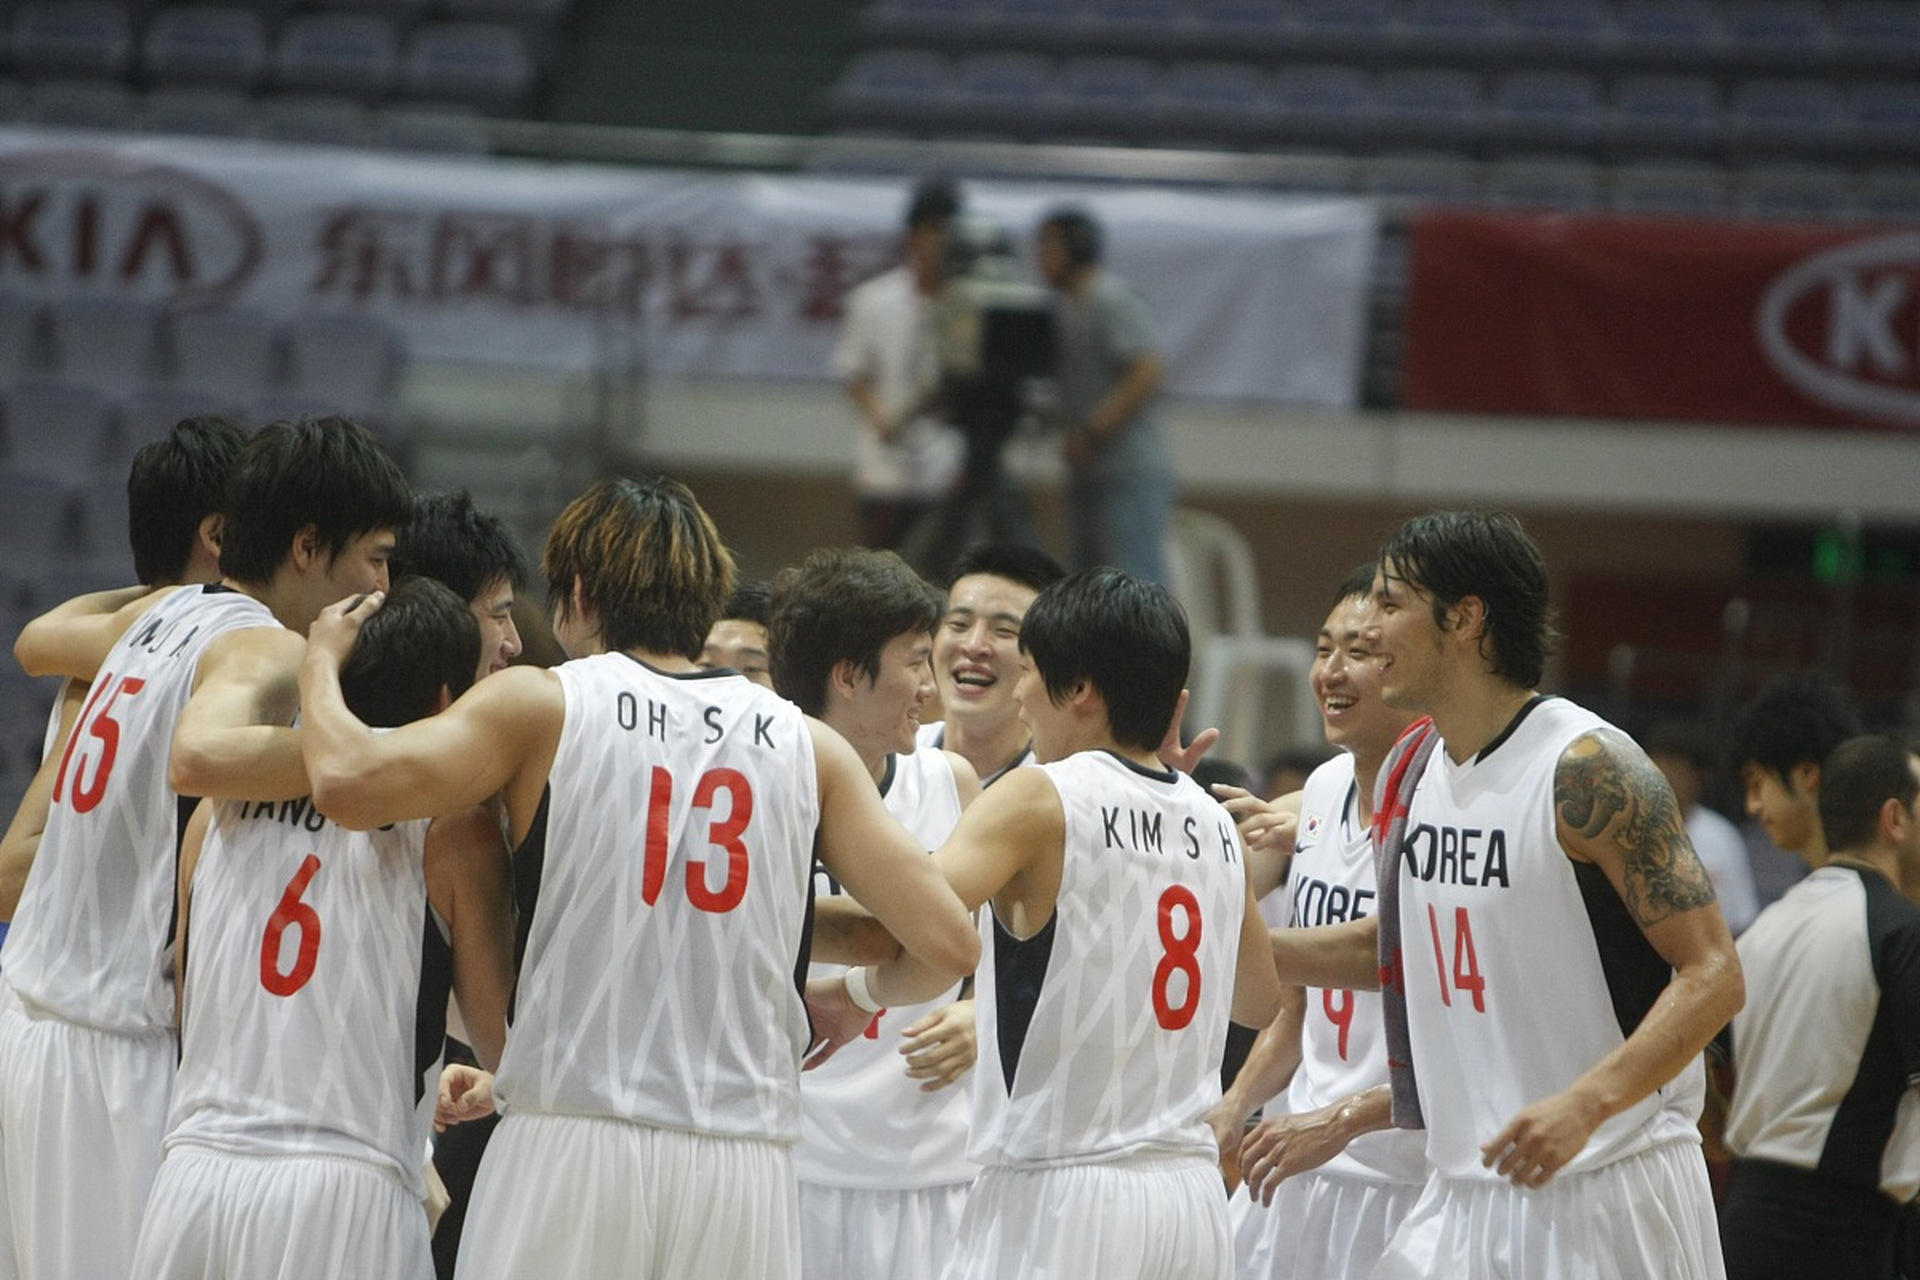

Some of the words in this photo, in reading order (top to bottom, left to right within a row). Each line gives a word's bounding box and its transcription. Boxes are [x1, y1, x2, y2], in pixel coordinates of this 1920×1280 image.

[0, 187, 196, 282] KIA
[52, 672, 145, 813] 15
[617, 691, 667, 743] OH
[703, 705, 725, 745] S
[754, 712, 777, 750] K
[641, 765, 754, 913] 13
[1101, 806, 1164, 855] KIM
[1183, 816, 1200, 860] S
[1217, 820, 1237, 863] H
[1400, 823, 1510, 889] KOREA
[260, 854, 321, 997] 6
[1288, 872, 1376, 928] KORE
[1152, 884, 1202, 1031] 8
[1428, 902, 1486, 1013] 14
